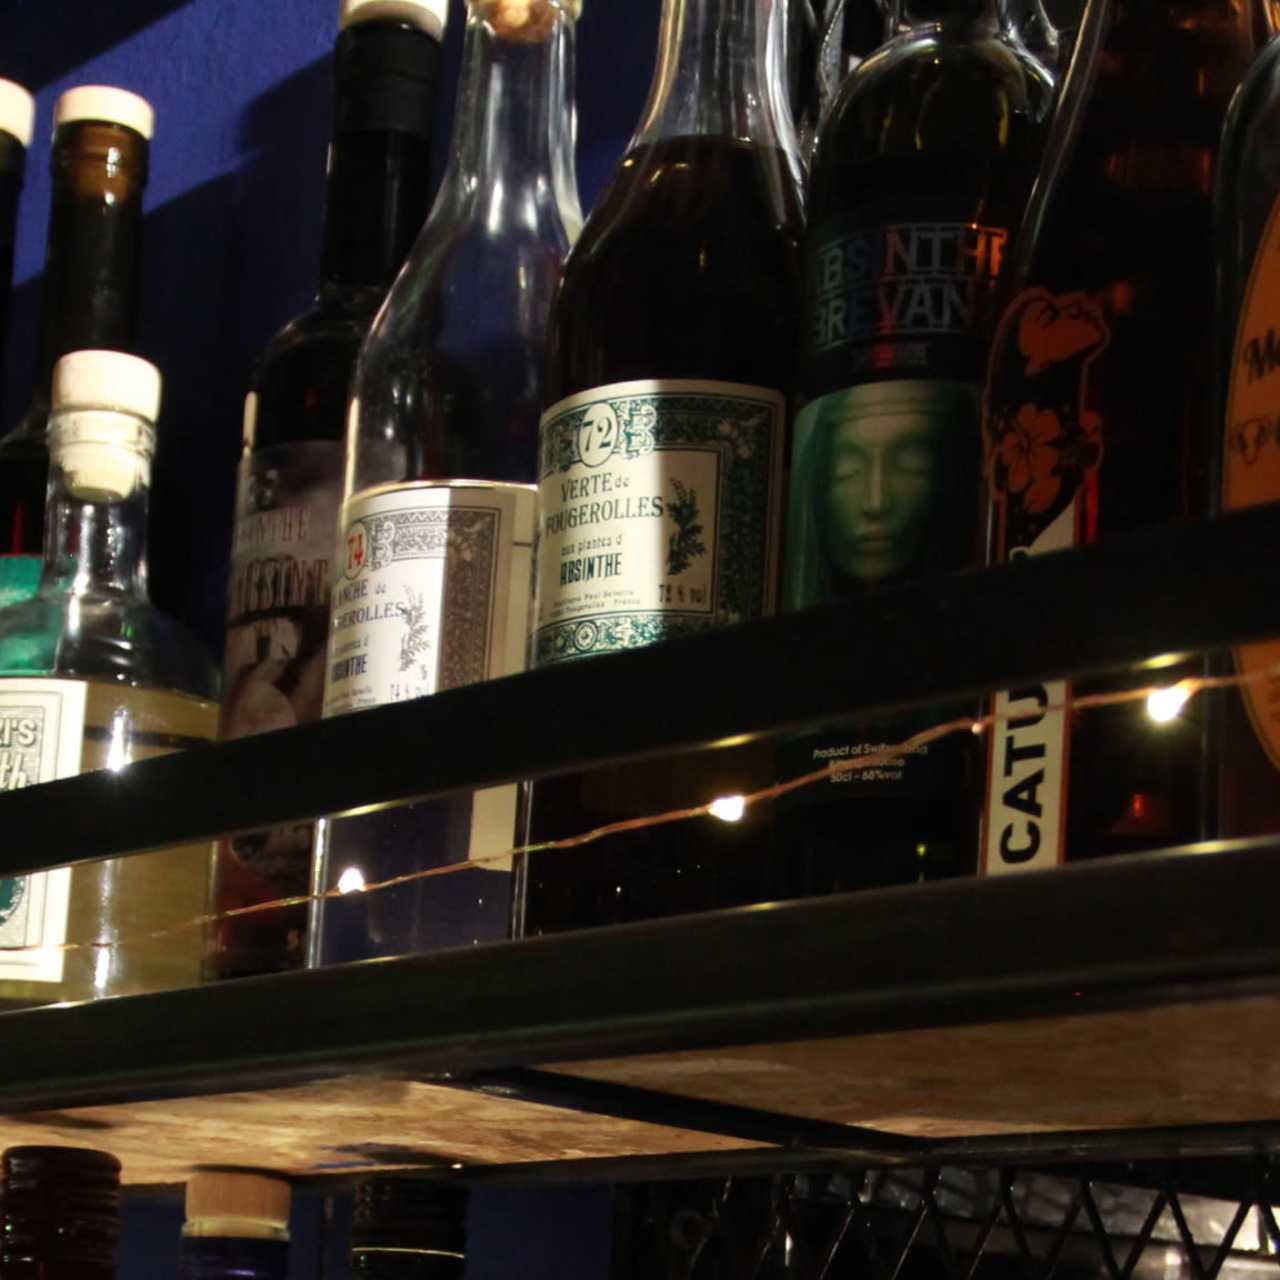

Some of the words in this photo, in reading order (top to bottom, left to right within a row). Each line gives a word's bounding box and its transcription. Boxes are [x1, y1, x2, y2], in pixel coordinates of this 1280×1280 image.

[581, 416, 613, 452] 72
[561, 471, 612, 502] VERTE
[545, 496, 665, 540] FOUGEROLLES
[346, 530, 365, 572] 74
[559, 552, 623, 586] ABSINTHE
[812, 745, 850, 761] Product
[851, 743, 863, 755] of
[1000, 684, 1049, 864] CATU
